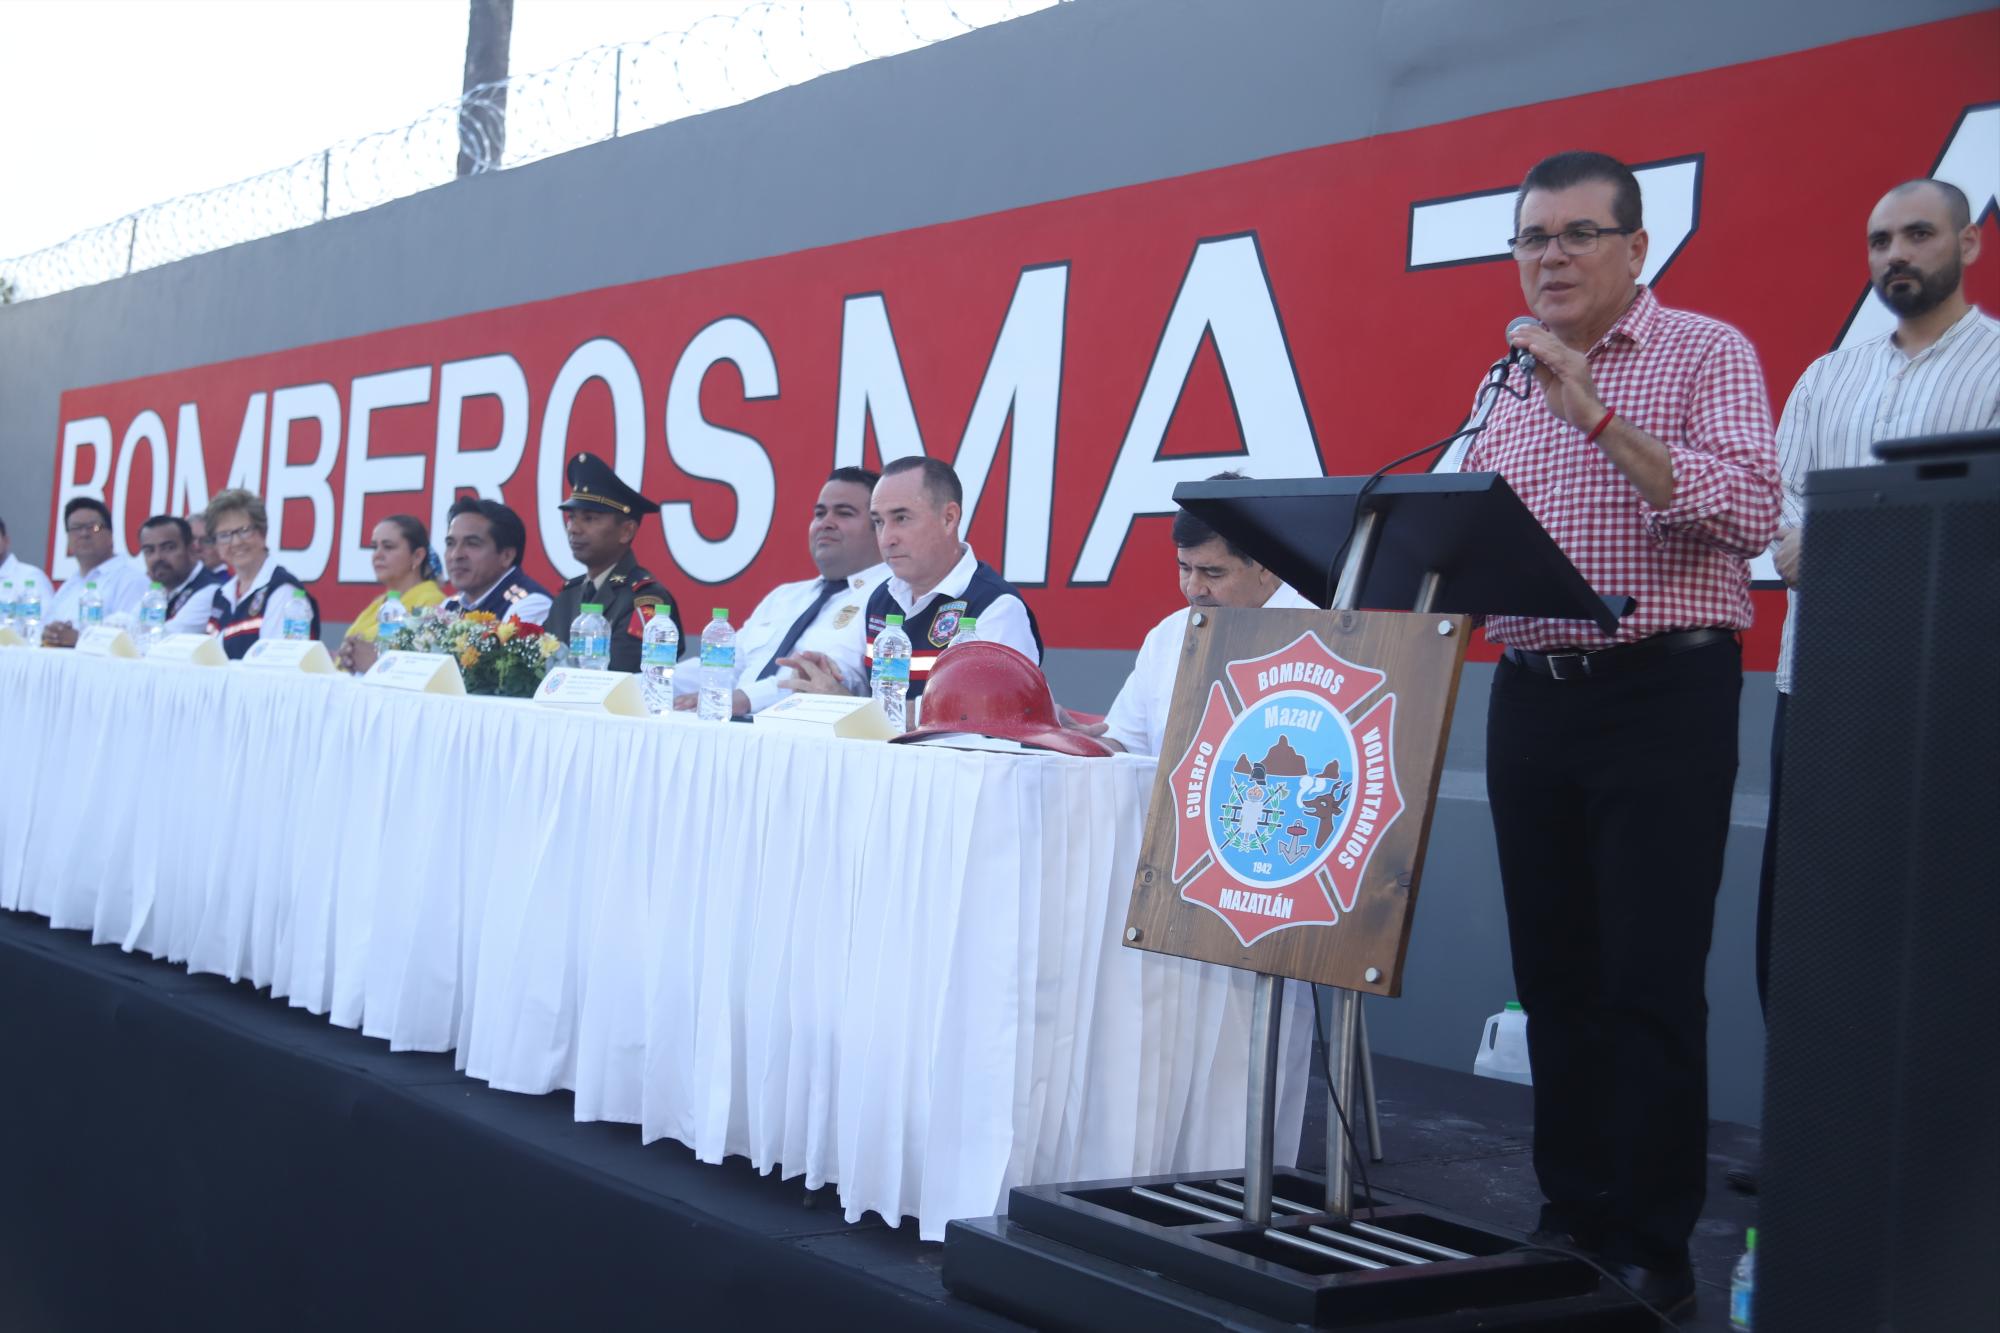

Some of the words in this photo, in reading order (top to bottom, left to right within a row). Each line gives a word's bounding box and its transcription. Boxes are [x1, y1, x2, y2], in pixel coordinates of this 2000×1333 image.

[51, 315, 780, 584] BOMBEROS
[1257, 662, 1345, 695] BOMBEROS
[1264, 706, 1323, 732] Mazatl
[1185, 741, 1214, 819] CUERPO
[1338, 726, 1385, 870] VOLUNTARIOS
[1252, 861, 1271, 875] 1942
[1218, 887, 1293, 919] MAZATLÁN
